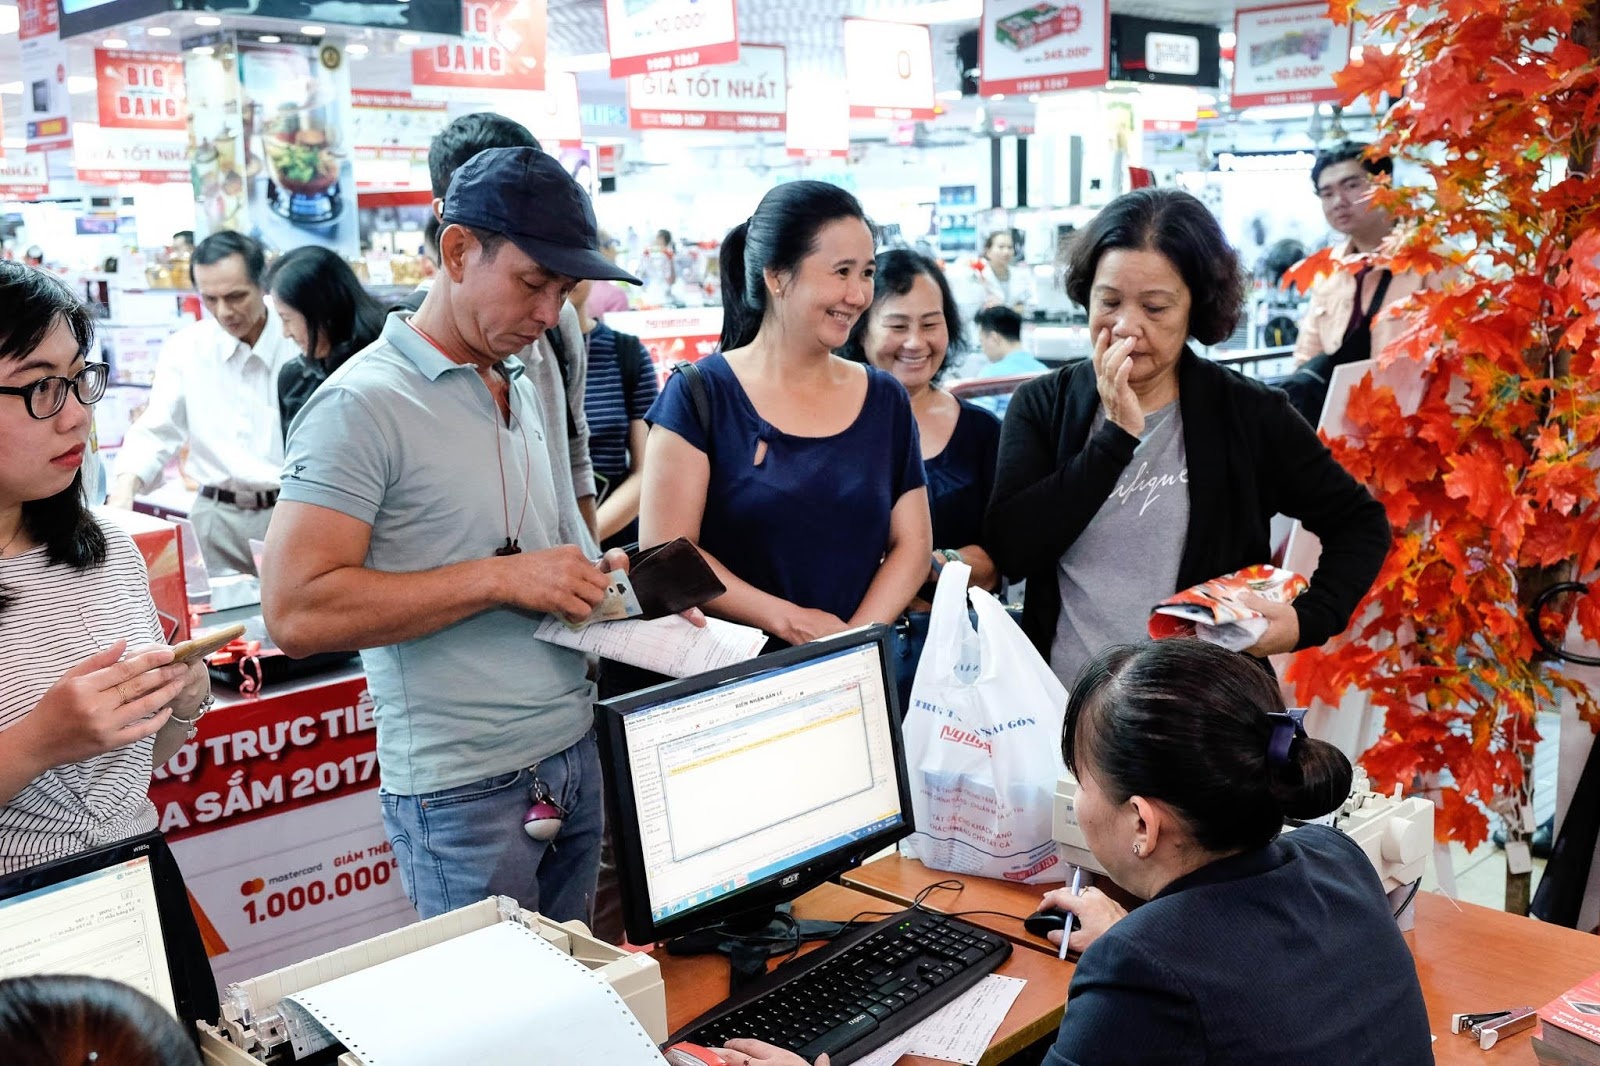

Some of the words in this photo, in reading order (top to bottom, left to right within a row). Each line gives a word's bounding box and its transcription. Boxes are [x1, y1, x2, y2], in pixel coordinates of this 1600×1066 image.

[463, 7, 487, 33] IG
[437, 43, 501, 71] BANG
[127, 67, 164, 87] BIG
[686, 70, 721, 98] TỐT
[727, 71, 777, 100] NHẤT
[119, 96, 177, 117] BANG
[153, 742, 199, 783] Ợ
[205, 713, 317, 767] TRỰC
[195, 768, 284, 824] SẮM
[290, 750, 377, 799] 2017
[268, 863, 323, 885] mastercard
[781, 872, 800, 887] acer
